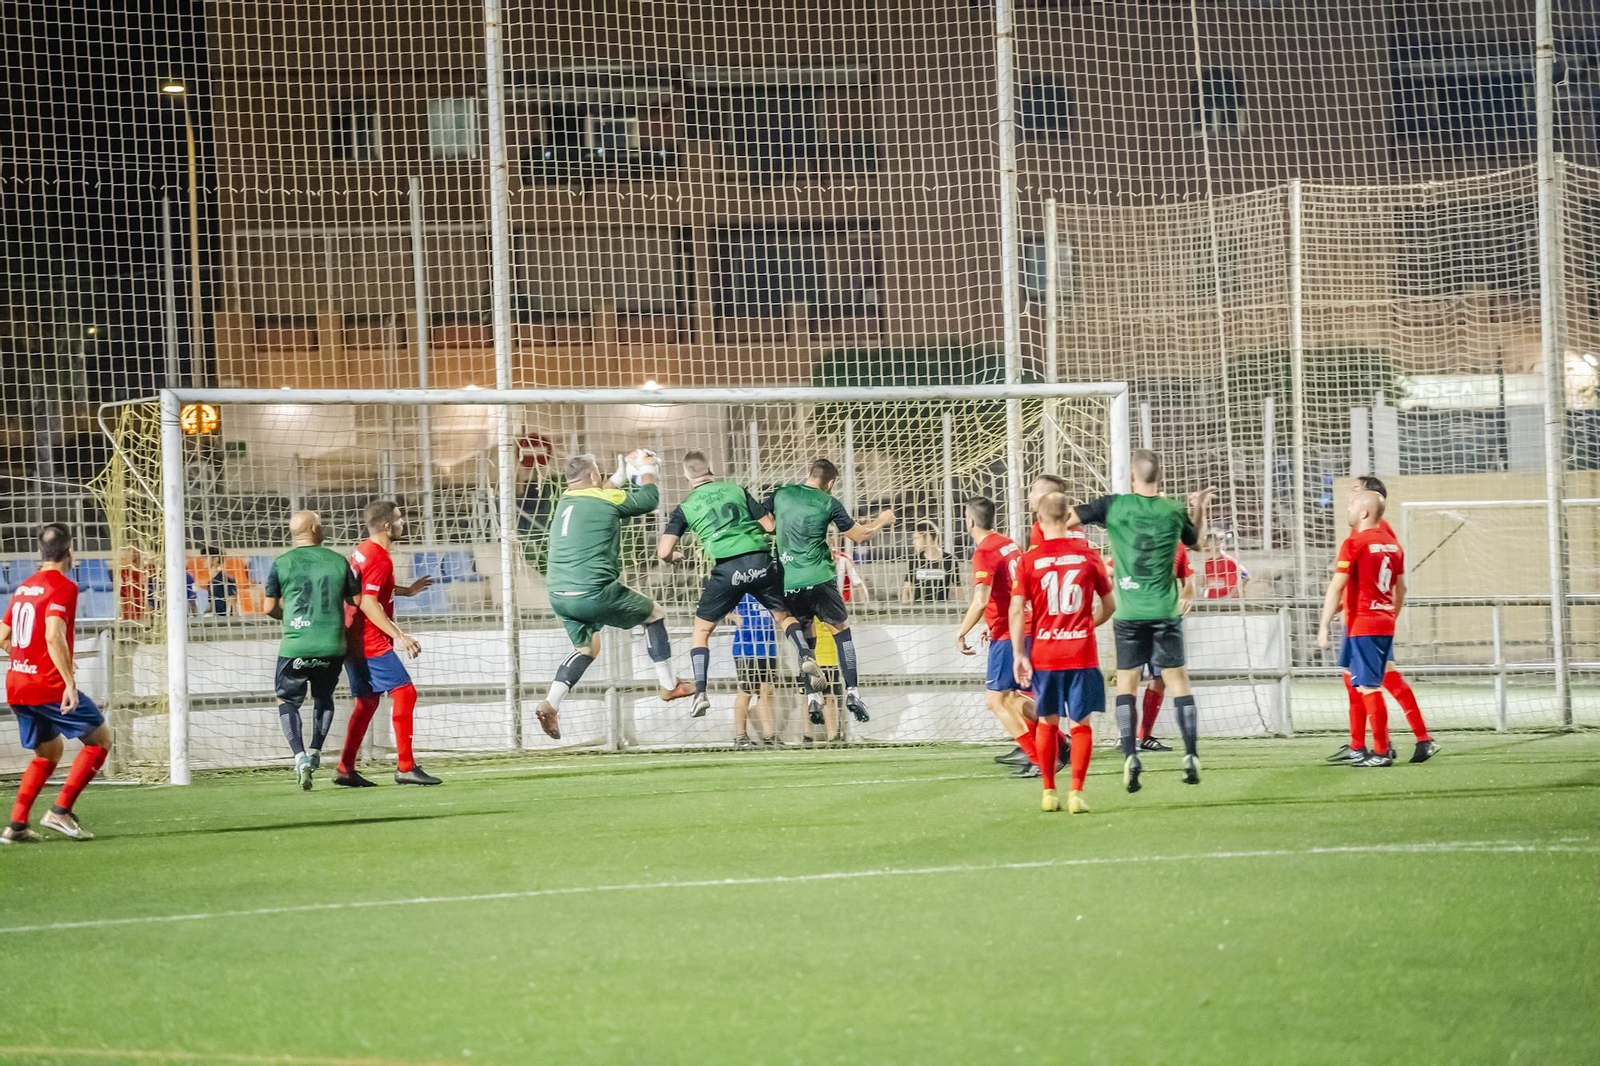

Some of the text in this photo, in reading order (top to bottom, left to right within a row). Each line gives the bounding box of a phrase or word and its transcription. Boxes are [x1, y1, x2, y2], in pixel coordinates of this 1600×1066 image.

[561, 505, 574, 537] 1
[1040, 569, 1083, 616] 16
[1378, 556, 1392, 593] 6
[293, 576, 330, 615] 21
[11, 602, 36, 649] 10
[290, 617, 311, 629] agro
